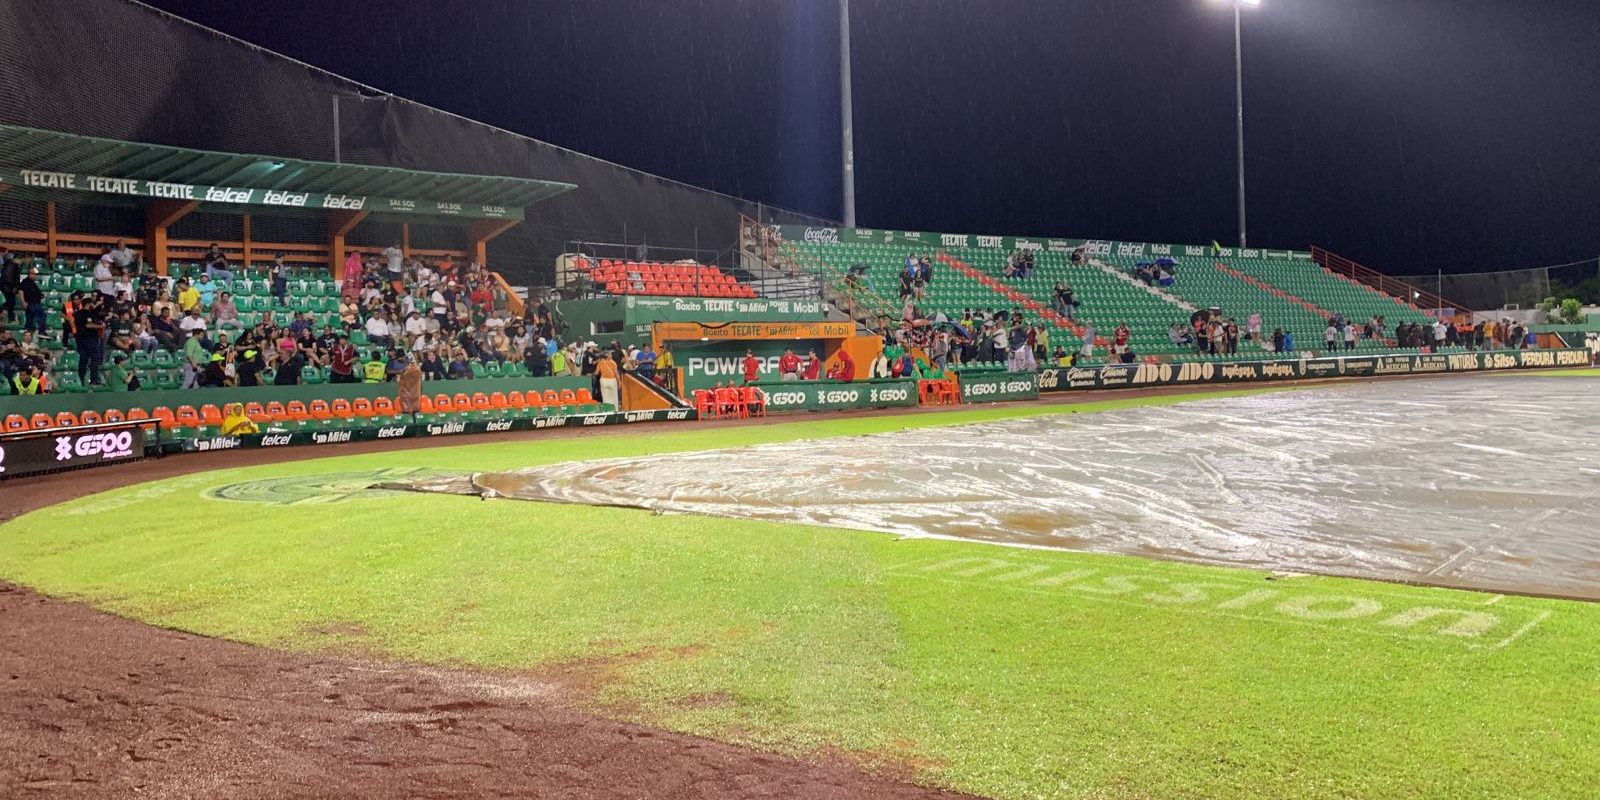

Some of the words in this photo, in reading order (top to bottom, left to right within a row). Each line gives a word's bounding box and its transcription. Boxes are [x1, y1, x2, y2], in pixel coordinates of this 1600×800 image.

[20, 169, 75, 188] TECATE
[86, 175, 138, 194] TECATE
[146, 181, 193, 199] TECATE
[205, 186, 253, 204] telcel
[263, 190, 309, 207] telcel
[322, 194, 367, 210] telcel
[941, 234, 968, 248] TECATE
[976, 235, 1003, 248] TECATE
[1084, 240, 1113, 256] telcel
[1117, 242, 1146, 257] telcel
[1151, 243, 1171, 255] Mobil
[1185, 245, 1204, 256] Mobil
[1219, 248, 1232, 257] 500
[1242, 249, 1258, 258] G500
[703, 300, 734, 311] TECATE
[748, 301, 769, 313] Mifel
[793, 302, 819, 313] Mobil
[731, 325, 761, 336] TECATE
[823, 325, 849, 336] Mobil
[1448, 353, 1478, 370] PINTURAS
[1520, 351, 1554, 366] PERDURA
[1556, 351, 1589, 365] PERDURA
[1132, 363, 1172, 383] ADO
[1176, 362, 1214, 381] ADO
[972, 383, 997, 395] G500
[1007, 381, 1031, 392] G500
[772, 391, 806, 404] G500
[827, 390, 859, 403] G500
[879, 389, 907, 402] G500
[583, 415, 607, 425] telcel
[635, 411, 654, 421] Mifel
[667, 410, 688, 420] telcel
[442, 421, 465, 433] Mifel
[486, 419, 512, 431] telcel
[545, 416, 567, 427] Mifel
[327, 430, 351, 442] Mifel
[377, 426, 406, 438] telcel
[75, 431, 132, 456] G500
[210, 437, 234, 449] Mifel
[261, 434, 291, 446] telcel
[924, 556, 1502, 637] mission
